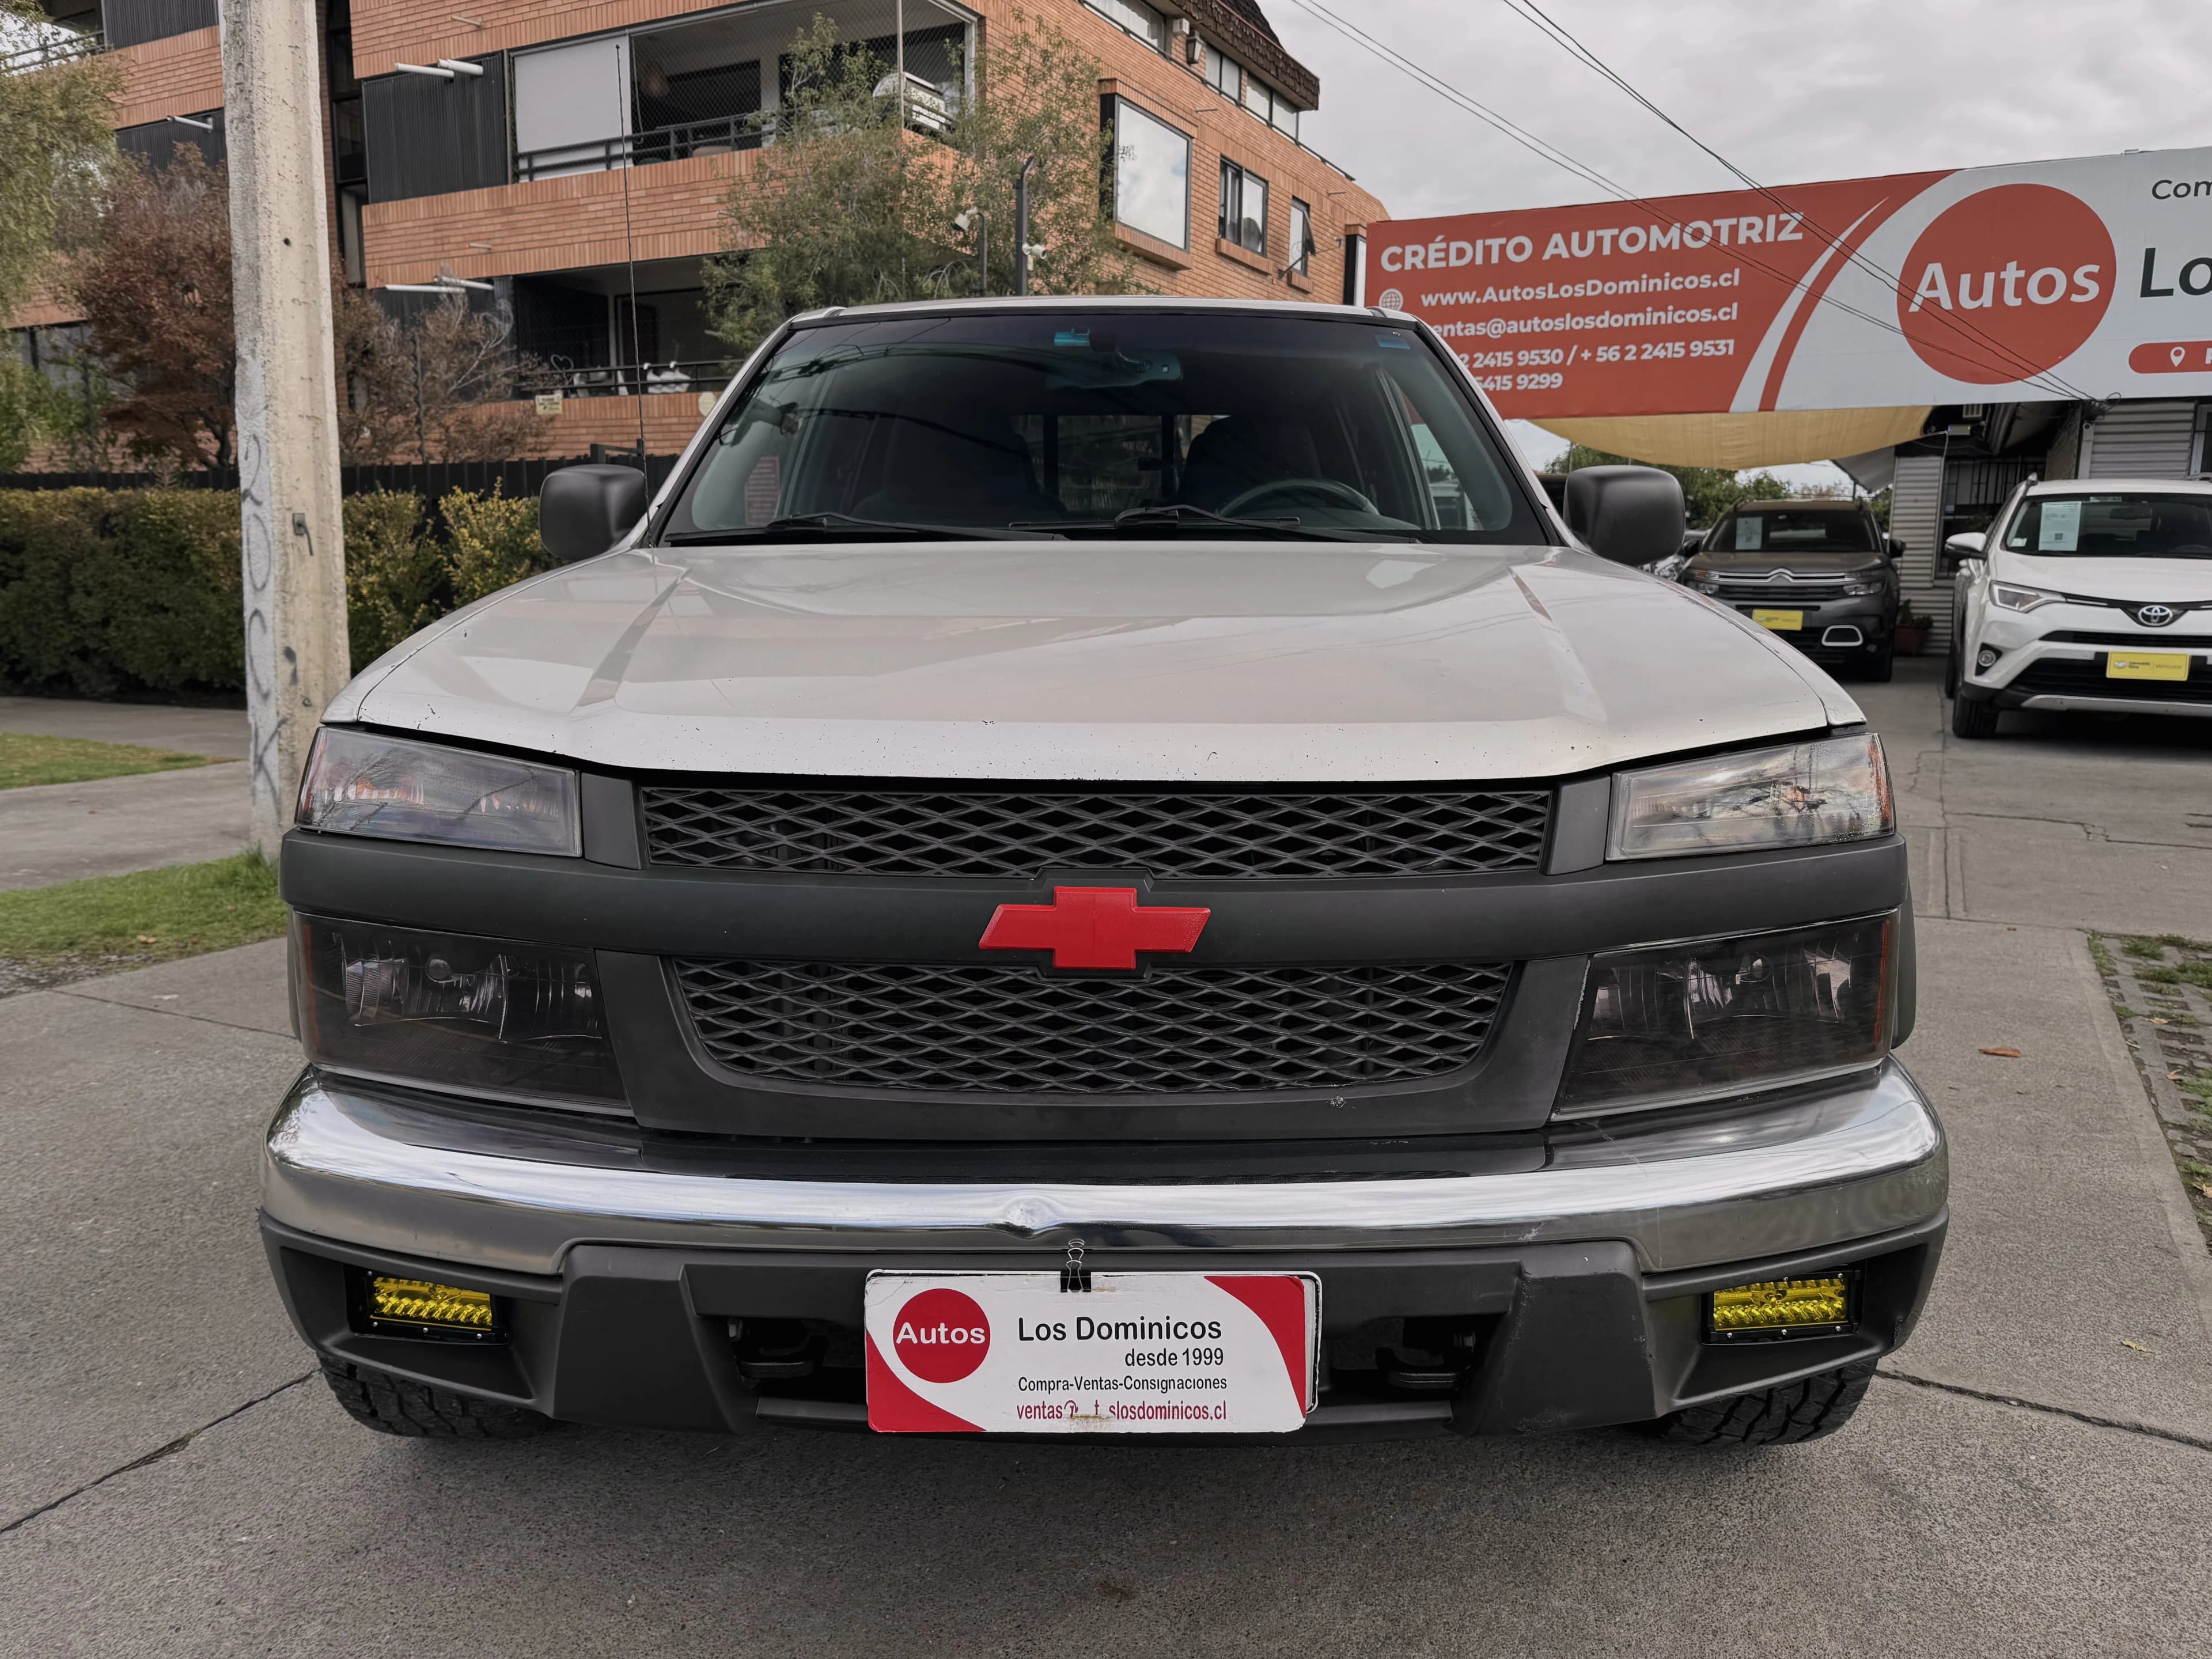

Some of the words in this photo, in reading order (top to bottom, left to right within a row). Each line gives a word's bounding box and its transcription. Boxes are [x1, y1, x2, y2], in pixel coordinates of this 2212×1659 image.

[1380, 234, 1533, 272] CRÉDITO
[1541, 211, 1804, 260] AUTOMOTRIZ
[1420, 267, 1740, 307] www.AutosLosDominicos.cl
[1908, 259, 2101, 313] Autos
[2139, 247, 2212, 298] Lo
[1432, 302, 1738, 339] entas@autoslosdominicos.cl
[1472, 350, 1514, 369] 2415
[1517, 349, 1564, 366] 9530
[1595, 345, 1621, 363] 56
[1623, 344, 1637, 361] 2
[1640, 341, 1686, 361] 2415
[1689, 338, 1735, 358] 9531
[1516, 373, 1563, 391] 9299
[895, 1322, 986, 1344] Autos
[1018, 1317, 1067, 1342] Los
[1076, 1315, 1222, 1340] Dominicos
[1124, 1347, 1178, 1367] desde
[1181, 1347, 1224, 1367] 1999
[1018, 1374, 1228, 1394] Compra-Ventas-Consignaciones
[1017, 1399, 1227, 1421] ventas@tslosdominicos.cl
